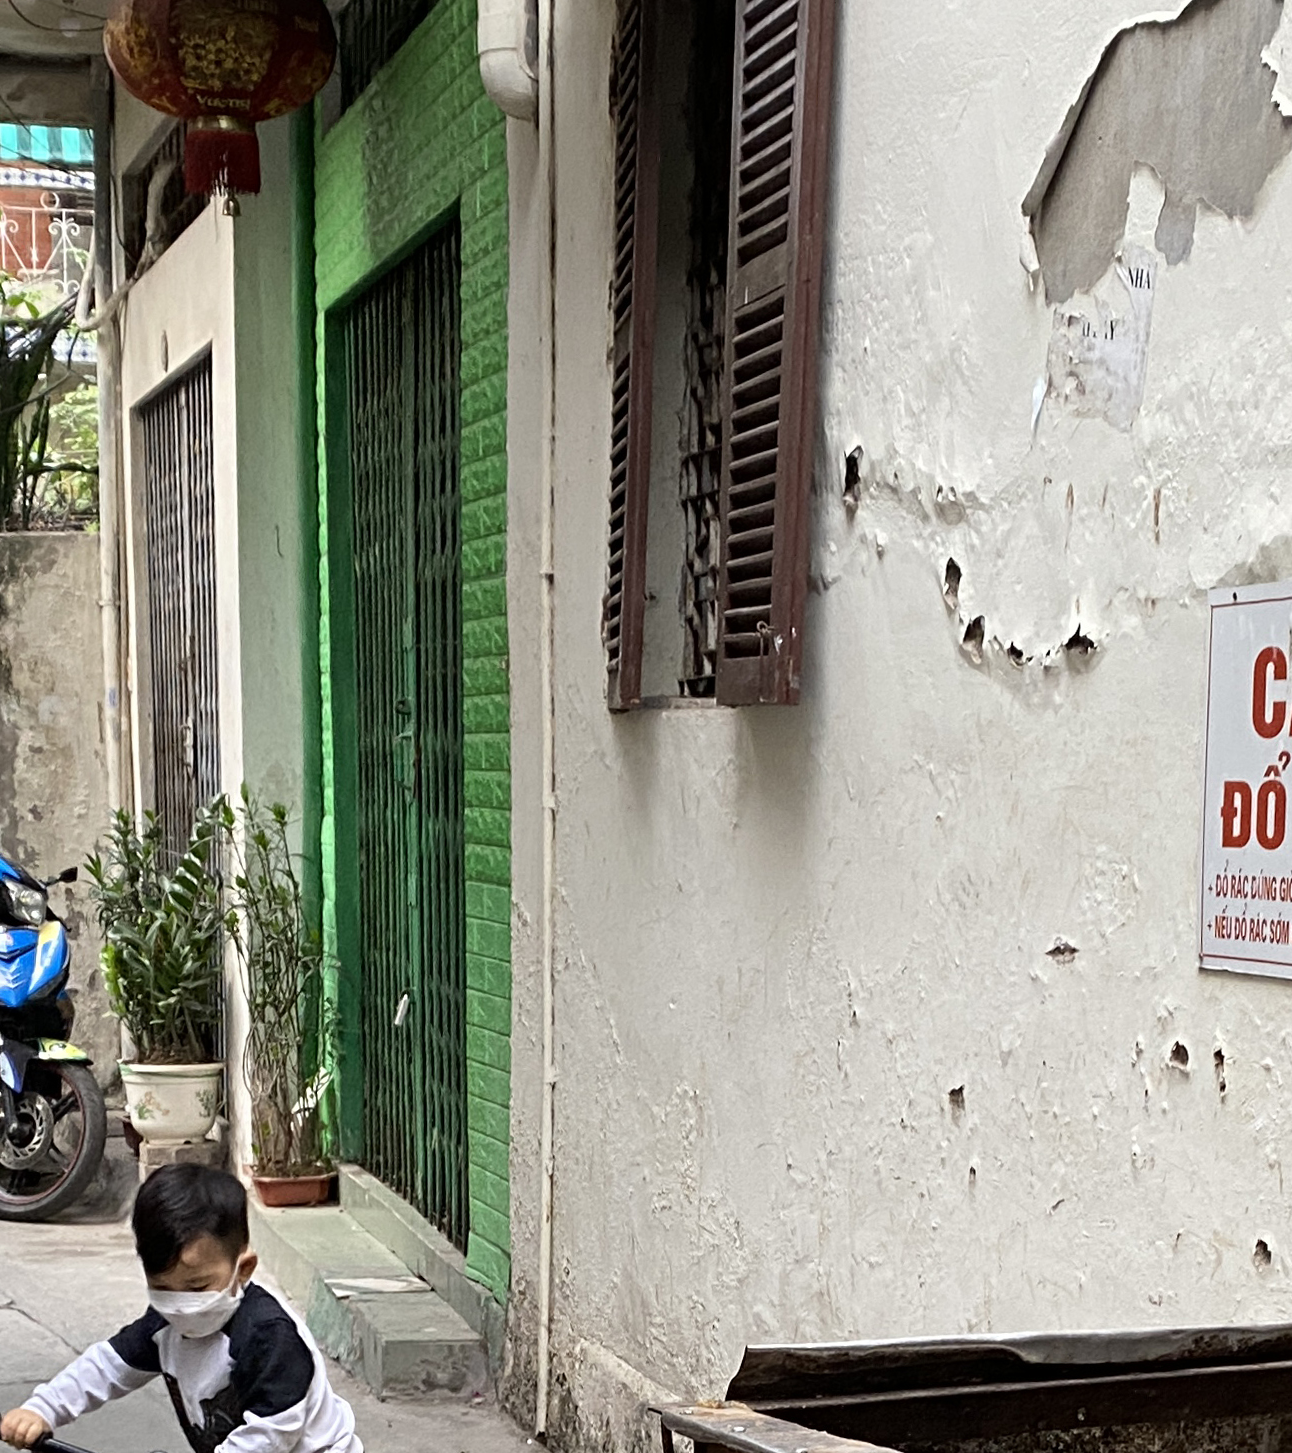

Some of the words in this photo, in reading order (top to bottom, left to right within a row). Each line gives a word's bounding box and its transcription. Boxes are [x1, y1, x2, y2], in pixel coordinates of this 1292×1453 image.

[1220, 751, 1292, 851] ĐỔ
[1230, 867, 1249, 899] RÁC
[1214, 904, 1233, 939] NẾU
[1234, 902, 1248, 941] ĐỔ
[1249, 912, 1268, 943] RÁC
[1269, 912, 1290, 945] SỚM
